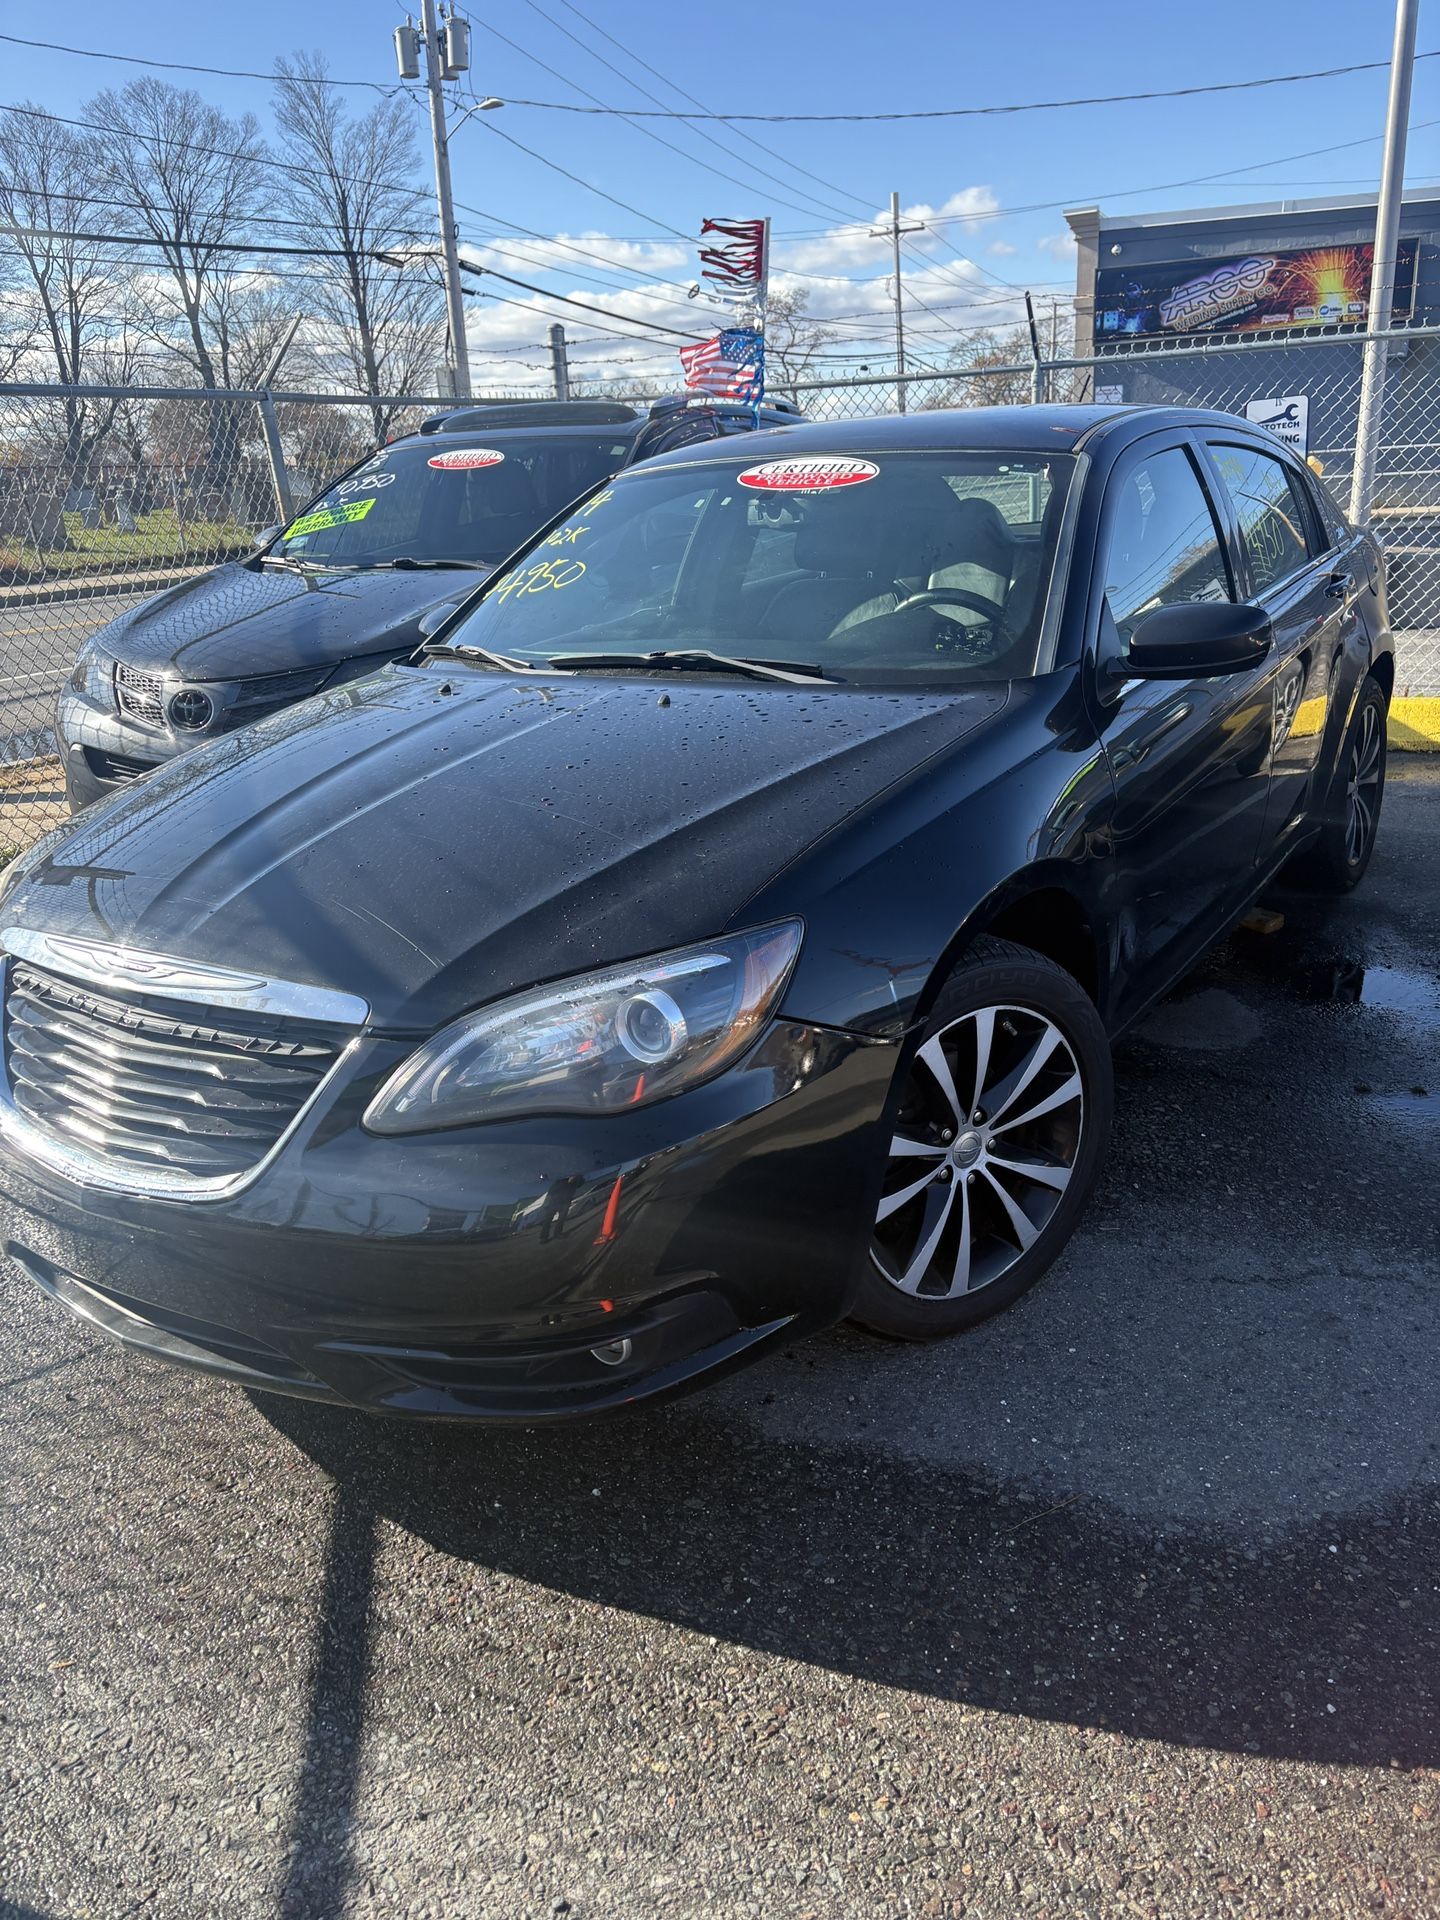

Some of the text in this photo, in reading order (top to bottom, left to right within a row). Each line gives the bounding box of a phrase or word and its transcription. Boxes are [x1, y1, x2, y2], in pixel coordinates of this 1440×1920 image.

[1161, 260, 1274, 323] ARCO
[1174, 285, 1274, 330] WELDING SUPPLY CO
[755, 473, 853, 482] PRE-OWNED
[758, 463, 867, 475] CERTIFIED
[291, 510, 362, 536] WARRANTY
